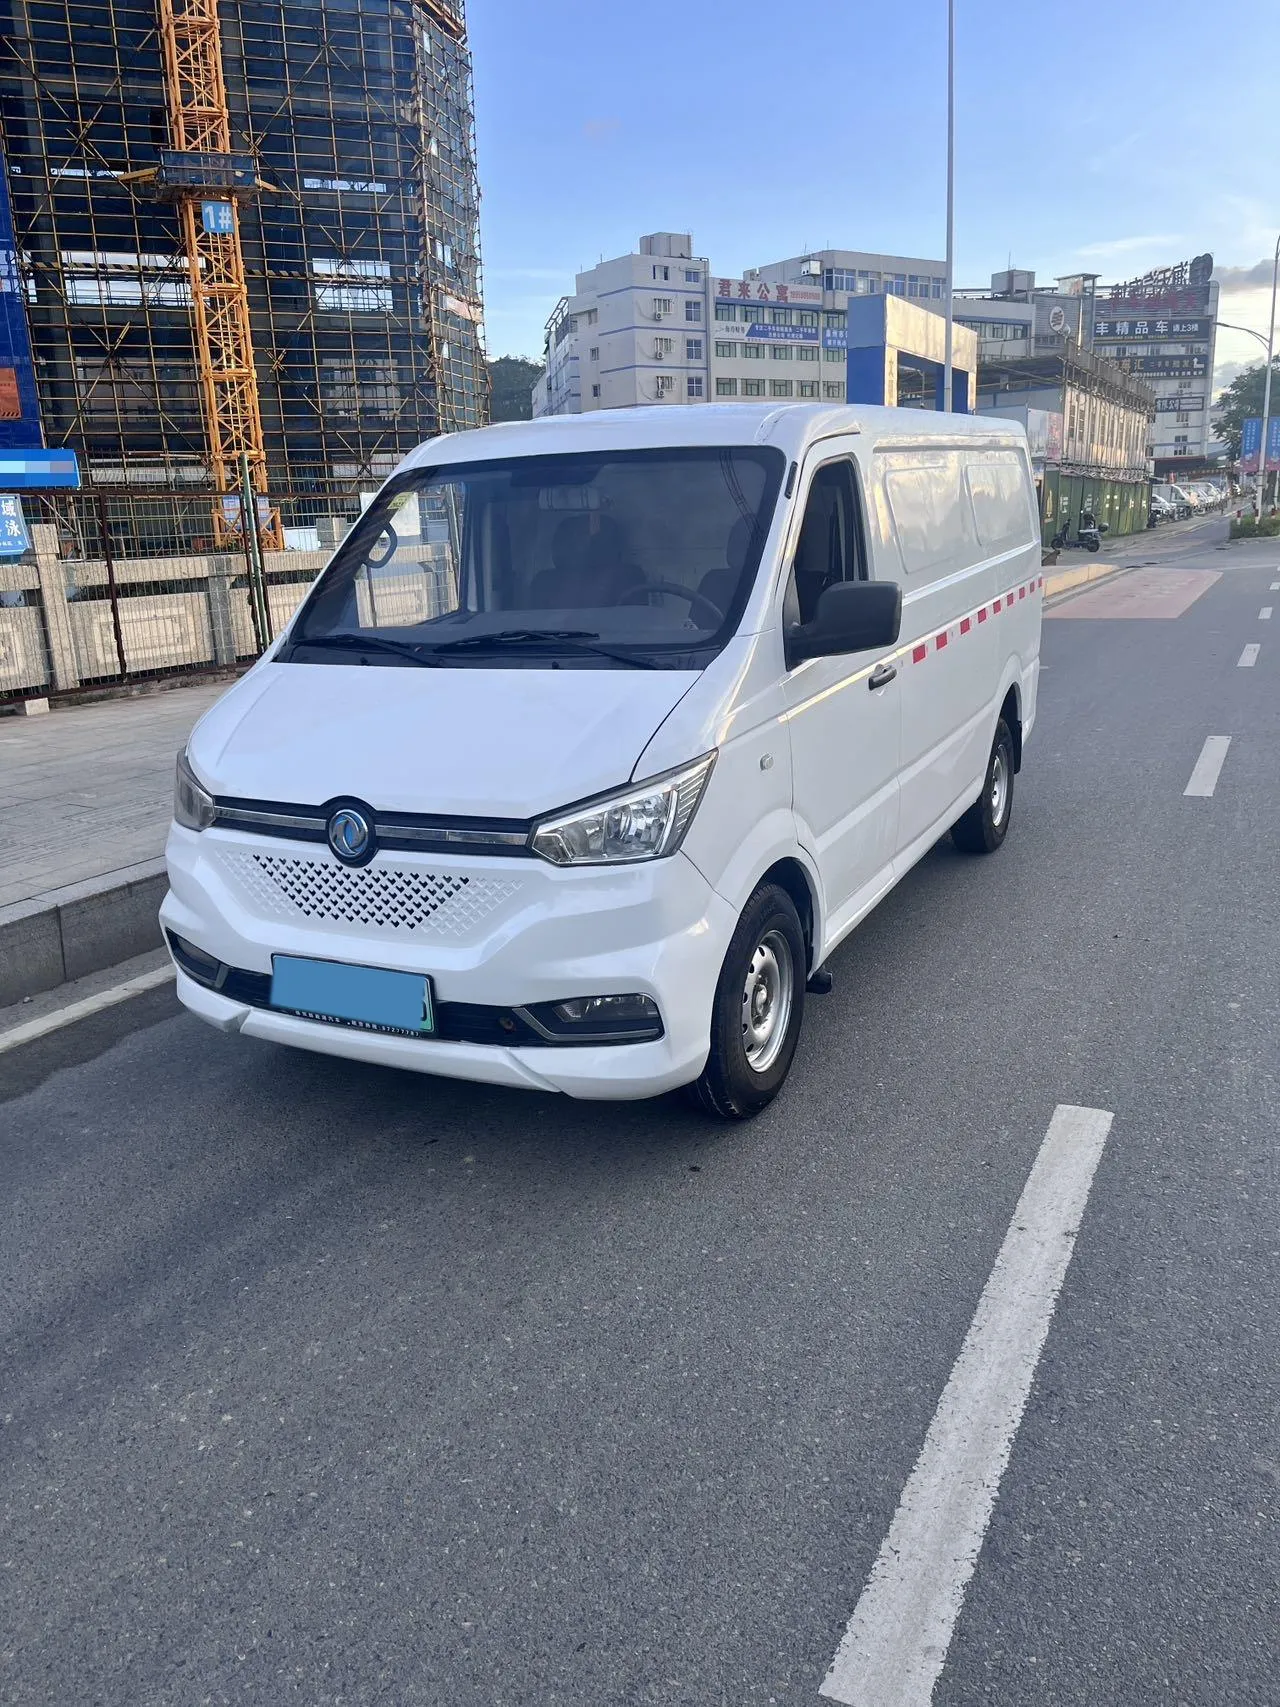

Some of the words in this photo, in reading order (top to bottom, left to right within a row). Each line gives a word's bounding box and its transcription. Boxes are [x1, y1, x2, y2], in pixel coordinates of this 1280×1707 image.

[204, 205, 232, 230] 1#
[718, 278, 789, 304] 君来公寓
[1095, 320, 1169, 336] 丰精品车
[1, 500, 17, 517] 域
[5, 519, 21, 537] 泳
